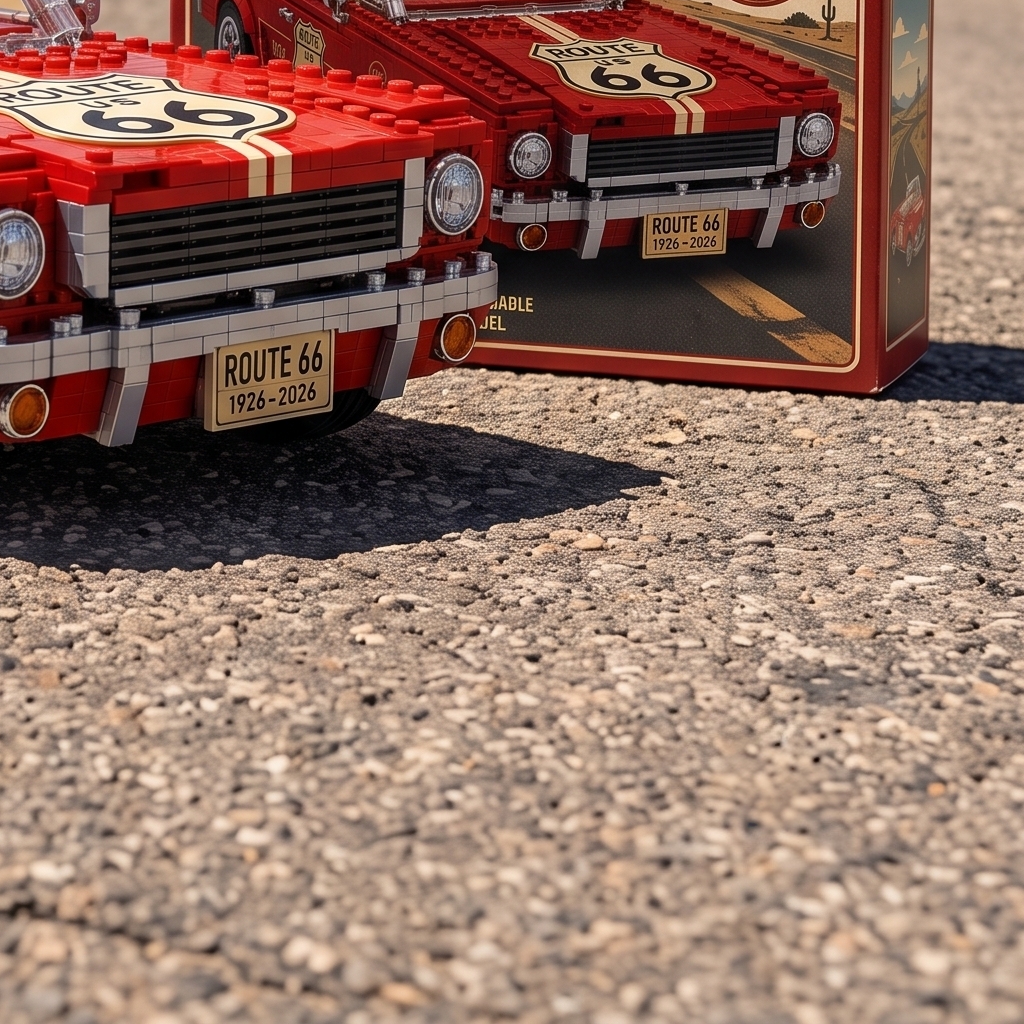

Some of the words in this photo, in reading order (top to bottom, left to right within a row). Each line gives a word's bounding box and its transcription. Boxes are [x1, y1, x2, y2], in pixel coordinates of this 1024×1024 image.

[545, 43, 645, 59] ROUTE
[590, 63, 692, 91] 66
[77, 98, 141, 109] US
[81, 100, 256, 134] 66
[652, 215, 698, 235] ROUTE
[703, 213, 720, 231] 66
[225, 345, 292, 388] ROUTE
[298, 340, 323, 375] 66
